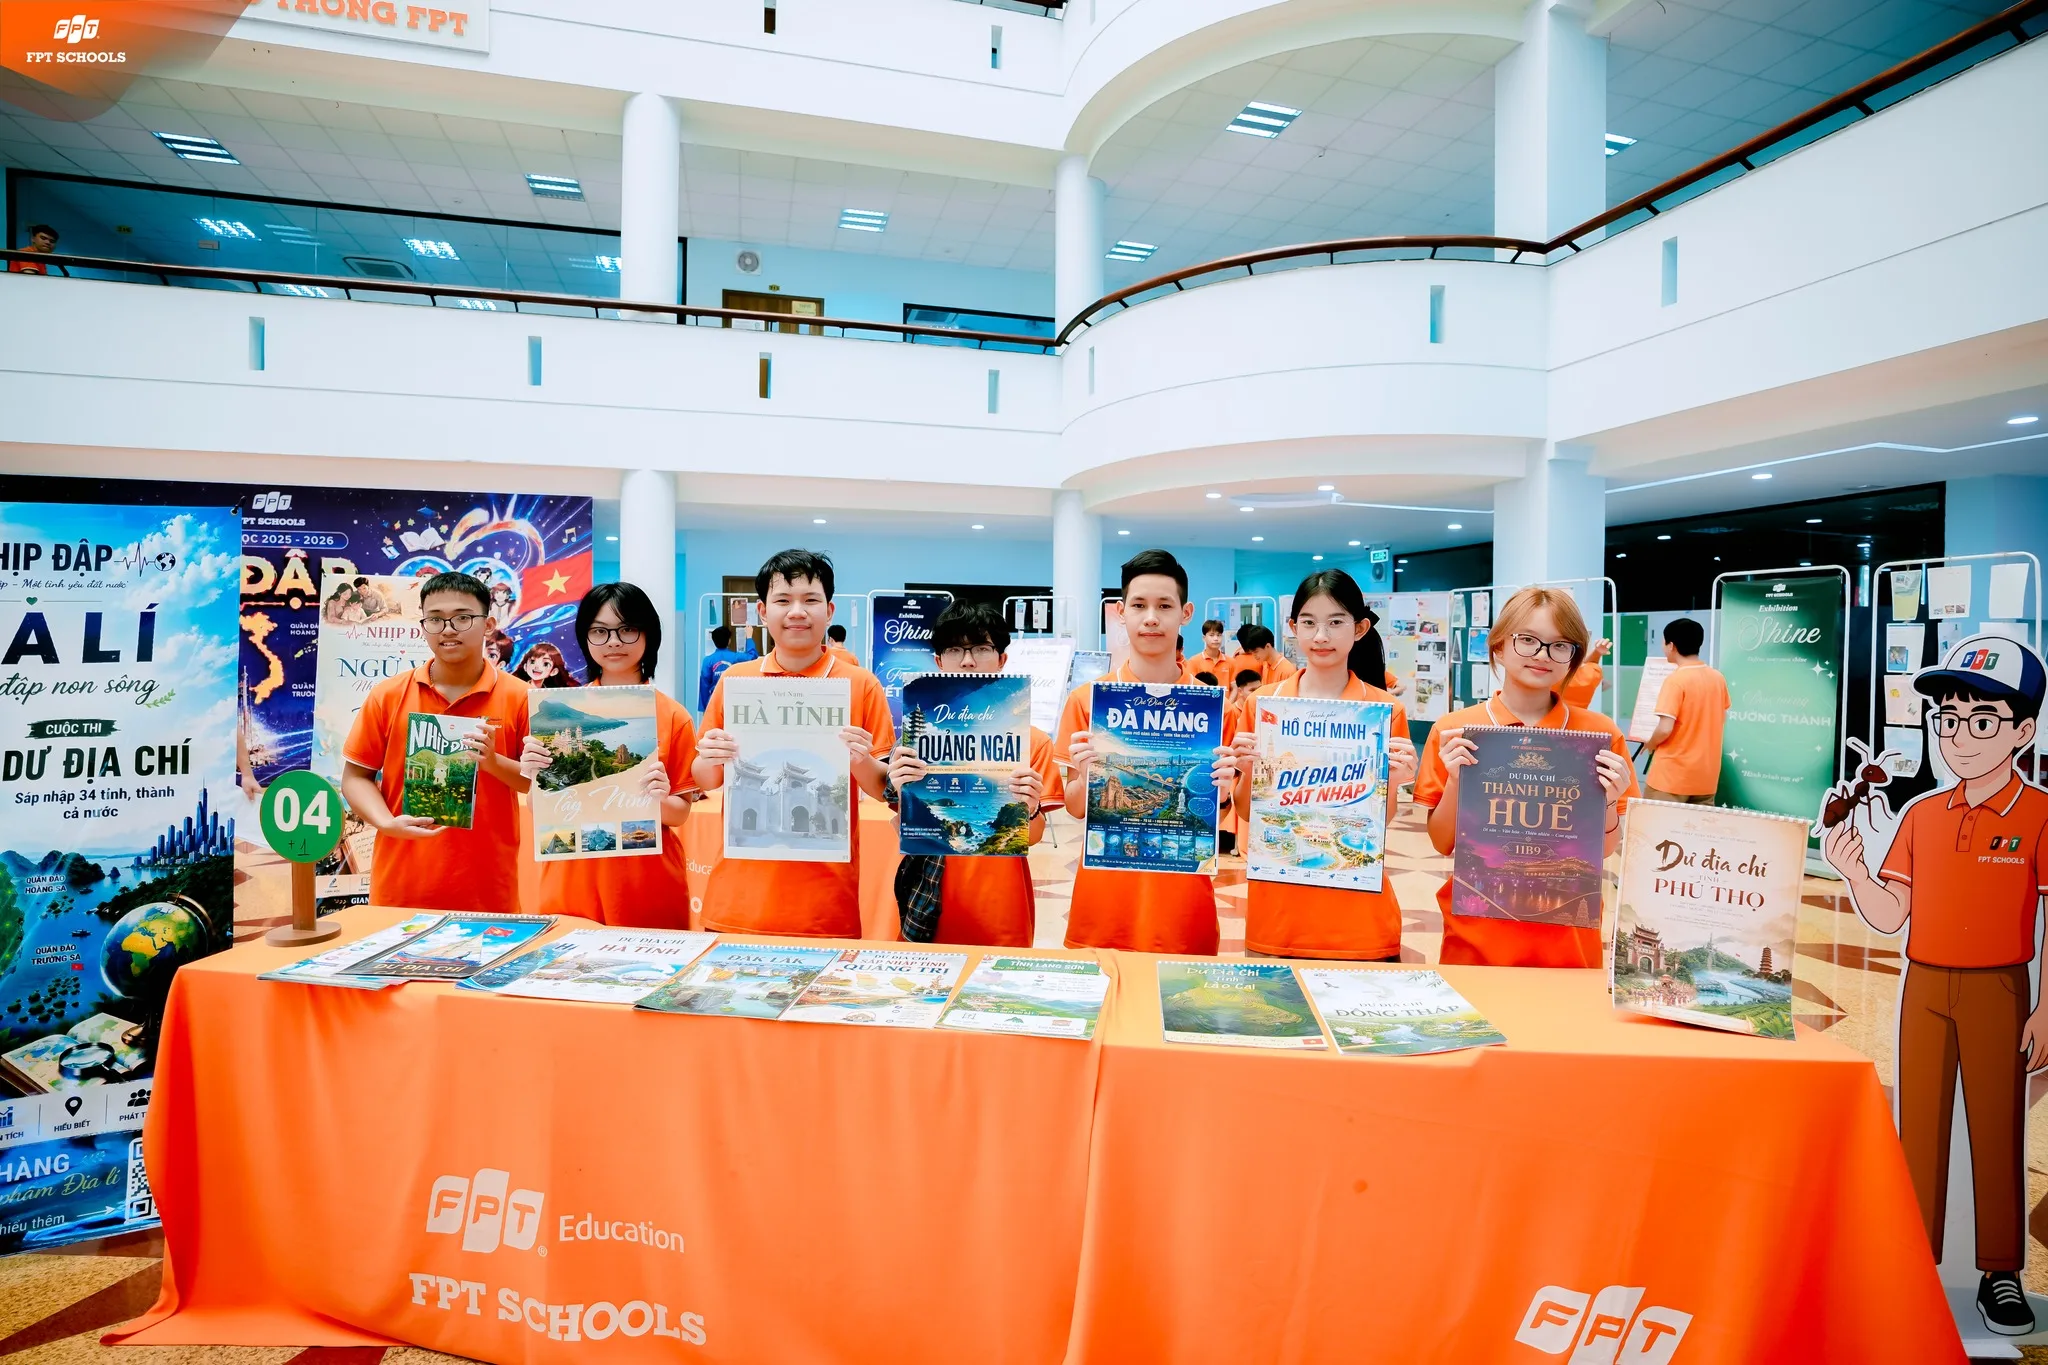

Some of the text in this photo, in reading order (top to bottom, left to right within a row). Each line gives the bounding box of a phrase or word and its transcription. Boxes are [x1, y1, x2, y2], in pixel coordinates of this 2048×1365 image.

[407, 6, 468, 36] FPT
[252, 491, 292, 513] FPT
[257, 518, 306, 526] SCHOOLS
[261, 534, 292, 544] 2025
[303, 536, 334, 545] 2026
[52, 538, 113, 577] ĐẬP
[366, 626, 406, 642] NHỊP
[884, 619, 933, 645] Shin
[1738, 615, 1821, 651] Shine
[334, 655, 402, 678] NGỮ
[1960, 649, 2000, 670] FPT
[52, 680, 98, 695] non
[104, 674, 160, 706] sông
[732, 699, 845, 727] HÀ TĨNH
[977, 705, 995, 721] chí
[1107, 703, 1139, 730] ĐÀ
[46, 721, 102, 736] CUỘC THI
[1303, 719, 1327, 738] CHÍ
[1330, 722, 1366, 740] MINH
[919, 729, 1021, 763] QUẢNG NGÃI
[2, 737, 192, 784] DƯ ĐỊA CHÍ
[1277, 759, 1368, 790] DƯ ĐỊA CHÍ
[1523, 774, 1538, 782] ĐỊA
[1540, 774, 1556, 782] CHÍ
[15, 792, 39, 806] Sáp
[43, 790, 75, 804] nhập
[79, 789, 96, 801] 34
[136, 785, 175, 798] thành
[1280, 782, 1367, 806] SÁT NHẬP
[1482, 780, 1581, 800] THÀNH PHỐ
[83, 805, 119, 818] nước
[274, 787, 331, 835] 04
[1487, 798, 1573, 831] HUẾ
[1515, 845, 1541, 855] 11B9
[1990, 836, 2022, 850] FPT
[1701, 847, 1731, 875] địa
[1738, 854, 1772, 878] chí
[1993, 857, 2025, 865] SCHOOLS
[1655, 878, 1764, 912] PHÚ THỌ
[70, 953, 81, 961] SA
[119, 1111, 140, 1121] PHÁT
[6, 1130, 24, 1140] TÍCH
[61, 1171, 102, 1195] Địa
[105, 1166, 121, 1186] lí
[32, 1214, 65, 1229] thêm
[426, 1168, 548, 1257] FPT
[559, 1213, 685, 1253] Education
[409, 1273, 707, 1346] FPT SCHOOLS
[1514, 1285, 1694, 1365] FPT
